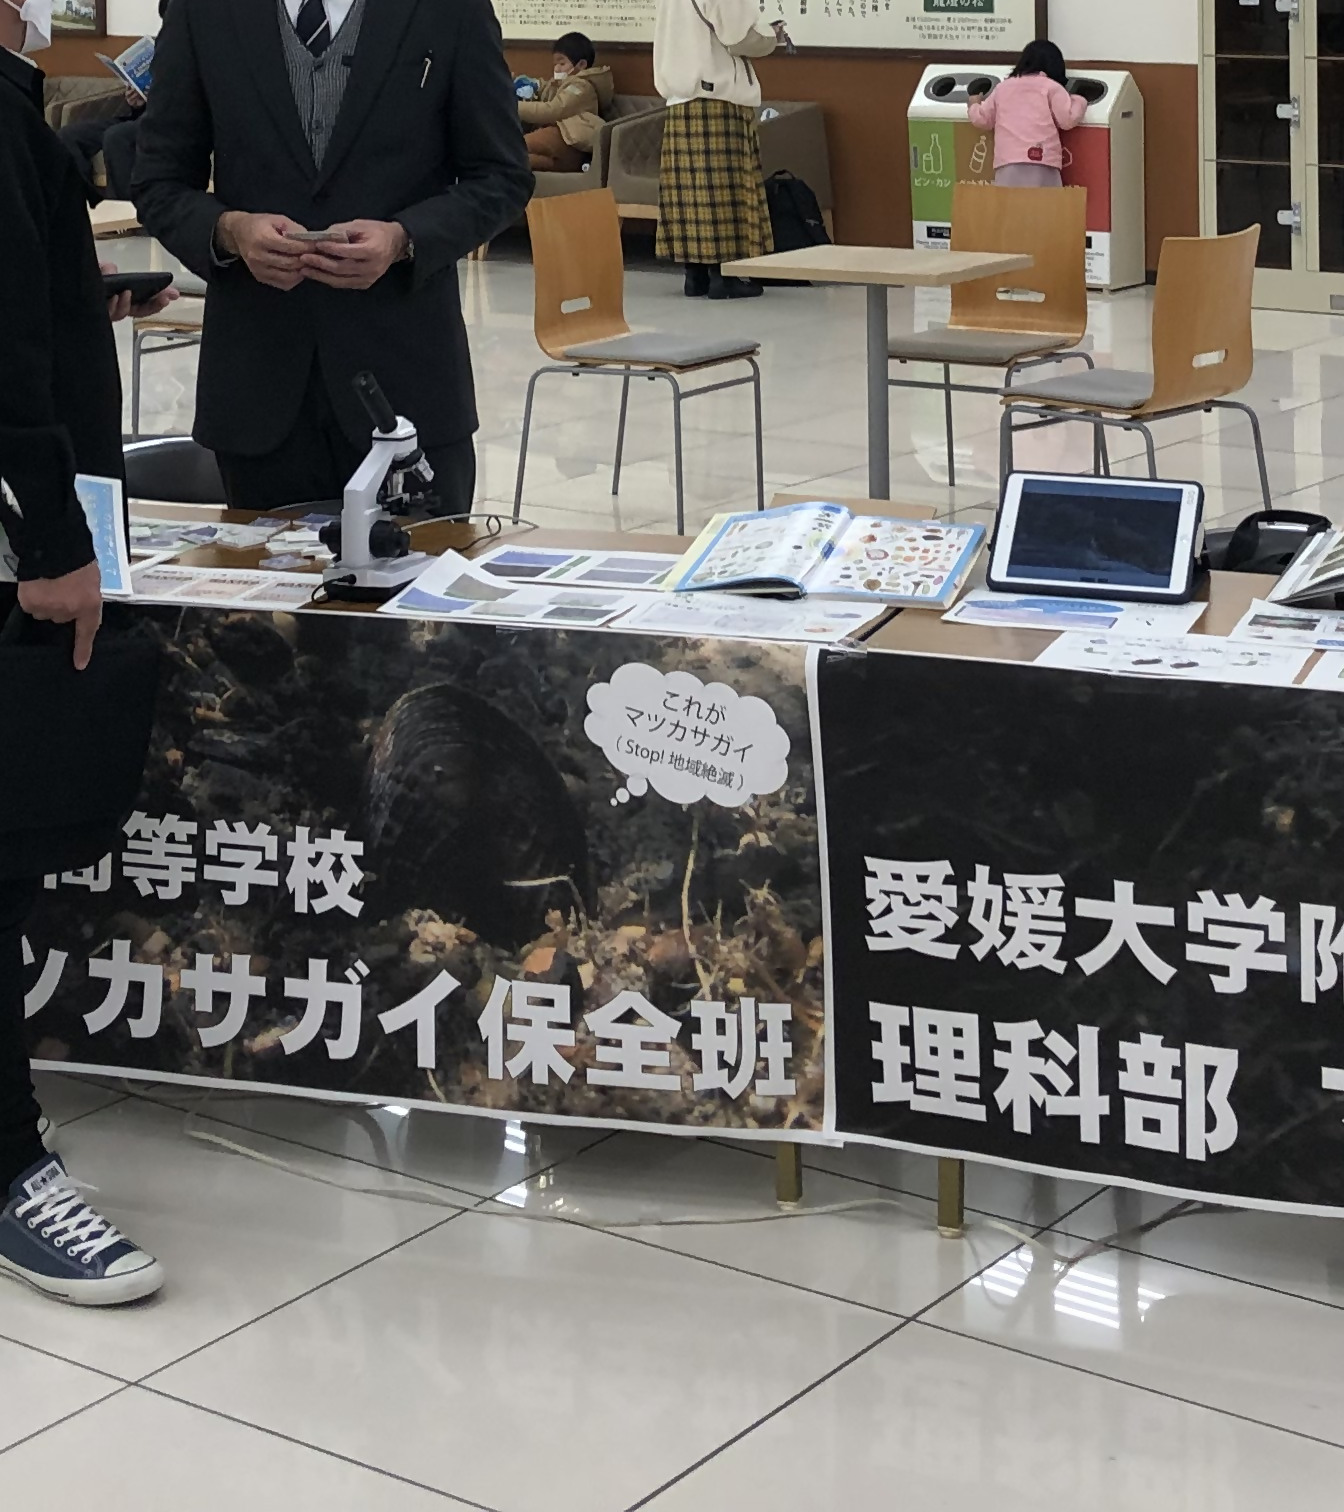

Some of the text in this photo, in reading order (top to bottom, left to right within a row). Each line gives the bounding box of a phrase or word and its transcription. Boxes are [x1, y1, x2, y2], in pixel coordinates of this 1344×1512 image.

[625, 706, 754, 763] マツカサガイ
[663, 691, 726, 725] これが
[868, 1001, 1240, 1162] 理科部
